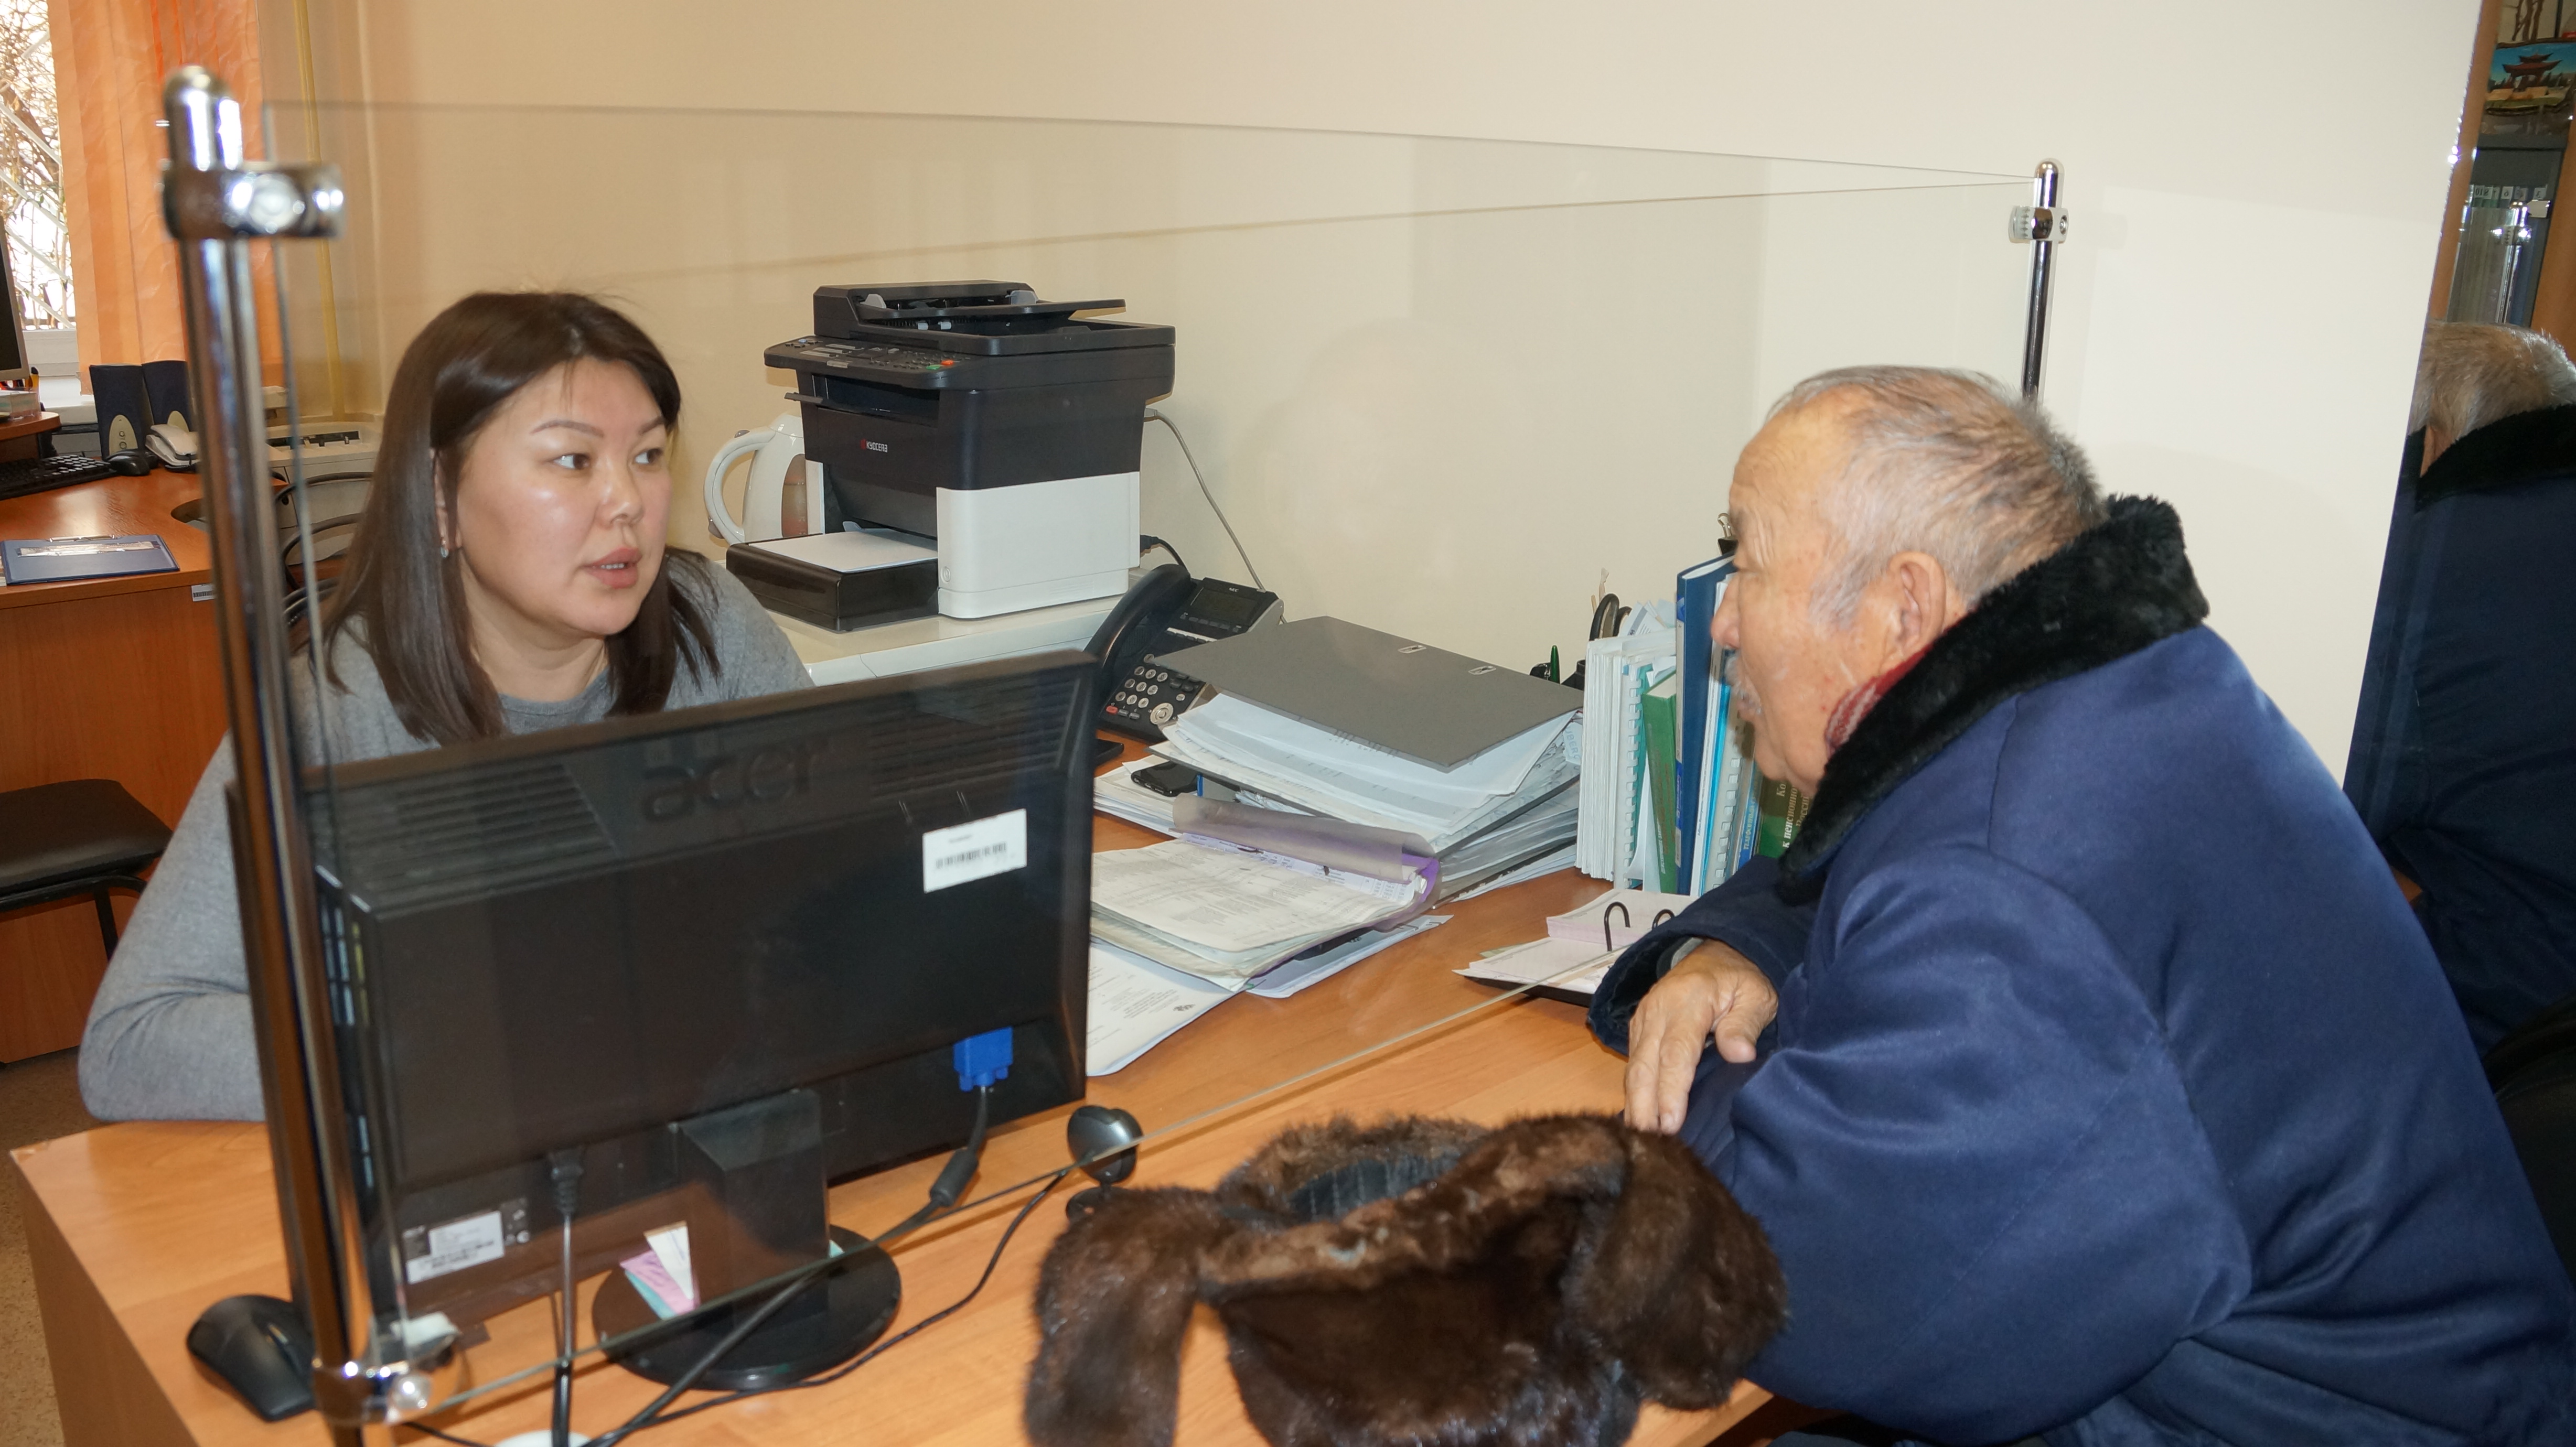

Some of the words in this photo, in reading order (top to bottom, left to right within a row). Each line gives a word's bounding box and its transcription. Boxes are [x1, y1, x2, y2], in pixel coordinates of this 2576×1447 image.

[866, 440, 888, 453] KYOCERA
[641, 737, 829, 823] acer
[1783, 785, 1798, 839] пенсионно
